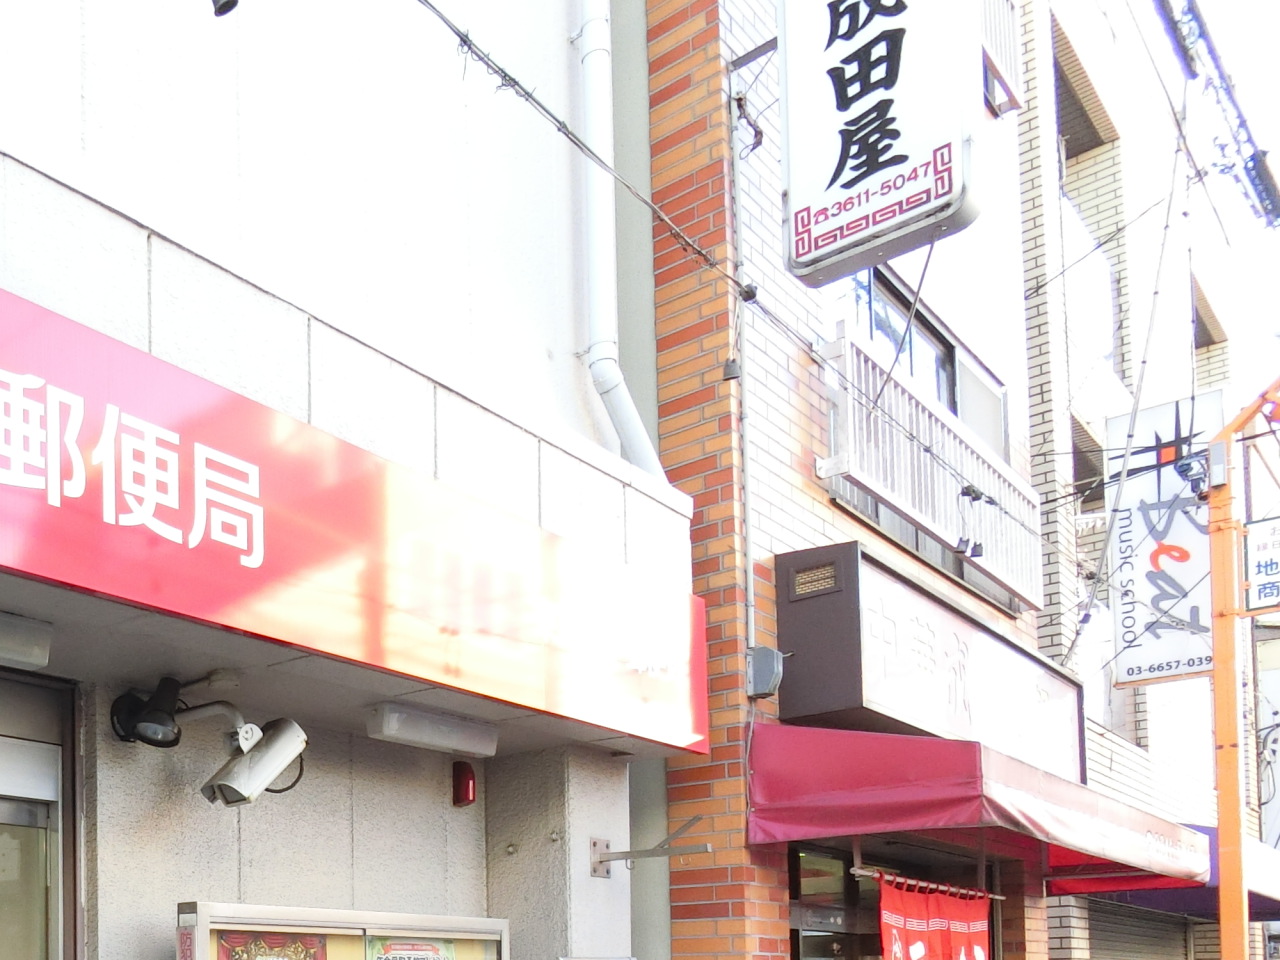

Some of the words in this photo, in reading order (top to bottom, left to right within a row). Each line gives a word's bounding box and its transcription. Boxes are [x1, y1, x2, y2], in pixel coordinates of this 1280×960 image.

[831, 161, 932, 217] 3611-5047
[1118, 508, 1136, 576] music
[1119, 580, 1142, 650] school
[1127, 655, 1213, 677] 03-6657-039
